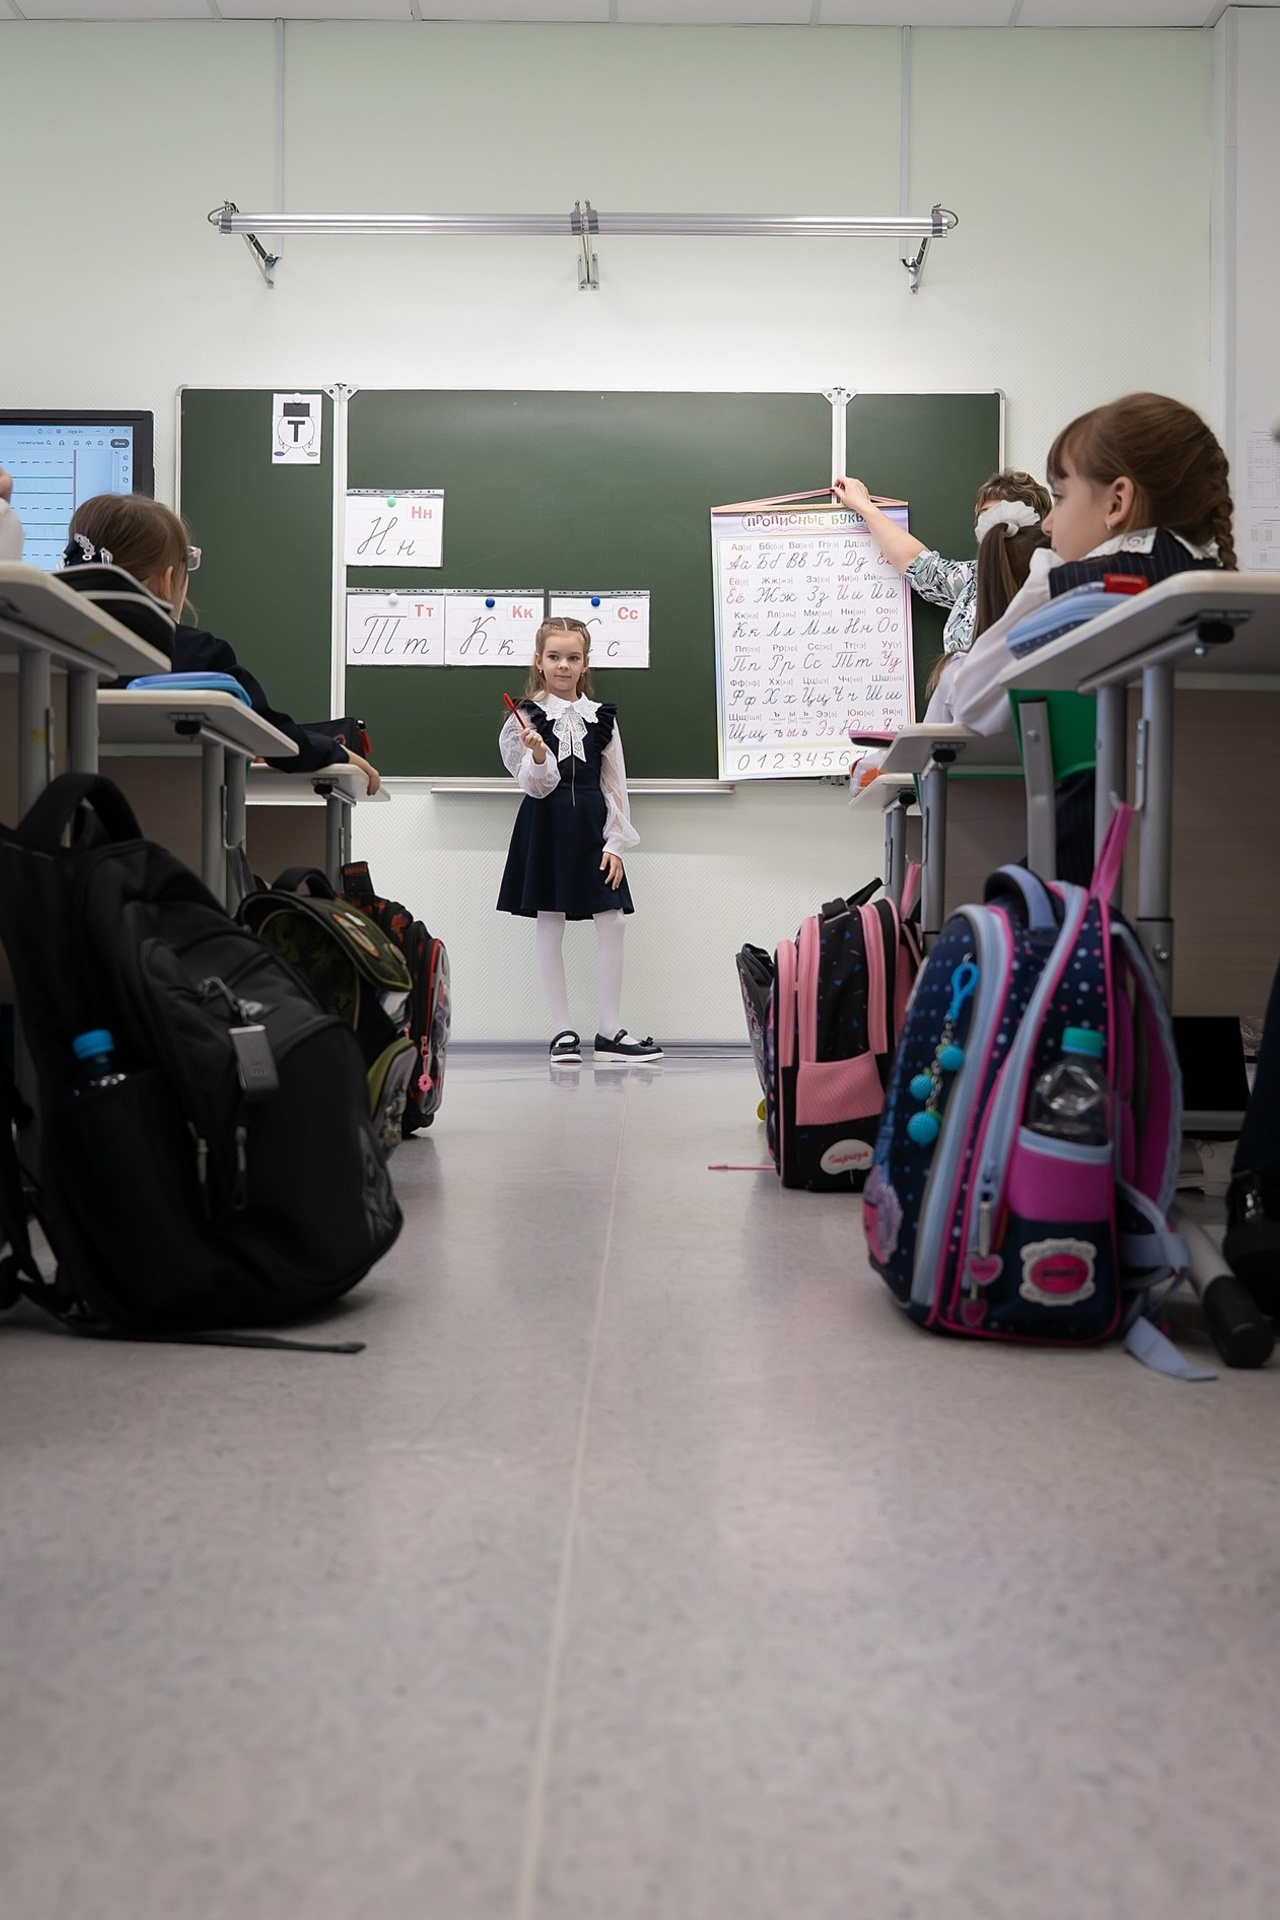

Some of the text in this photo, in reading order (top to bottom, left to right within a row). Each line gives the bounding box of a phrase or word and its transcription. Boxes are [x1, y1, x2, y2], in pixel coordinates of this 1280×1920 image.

[411, 505, 433, 520] Нн
[747, 513, 867, 528] ПРОПИСНЫЕ БУКВ
[414, 603, 434, 617] Тт
[512, 605, 533, 619] Кк
[617, 606, 638, 620] Сс
[773, 752, 785, 770] 2
[790, 751, 801, 769] 3
[806, 751, 818, 768] 4
[822, 750, 835, 767] 5
